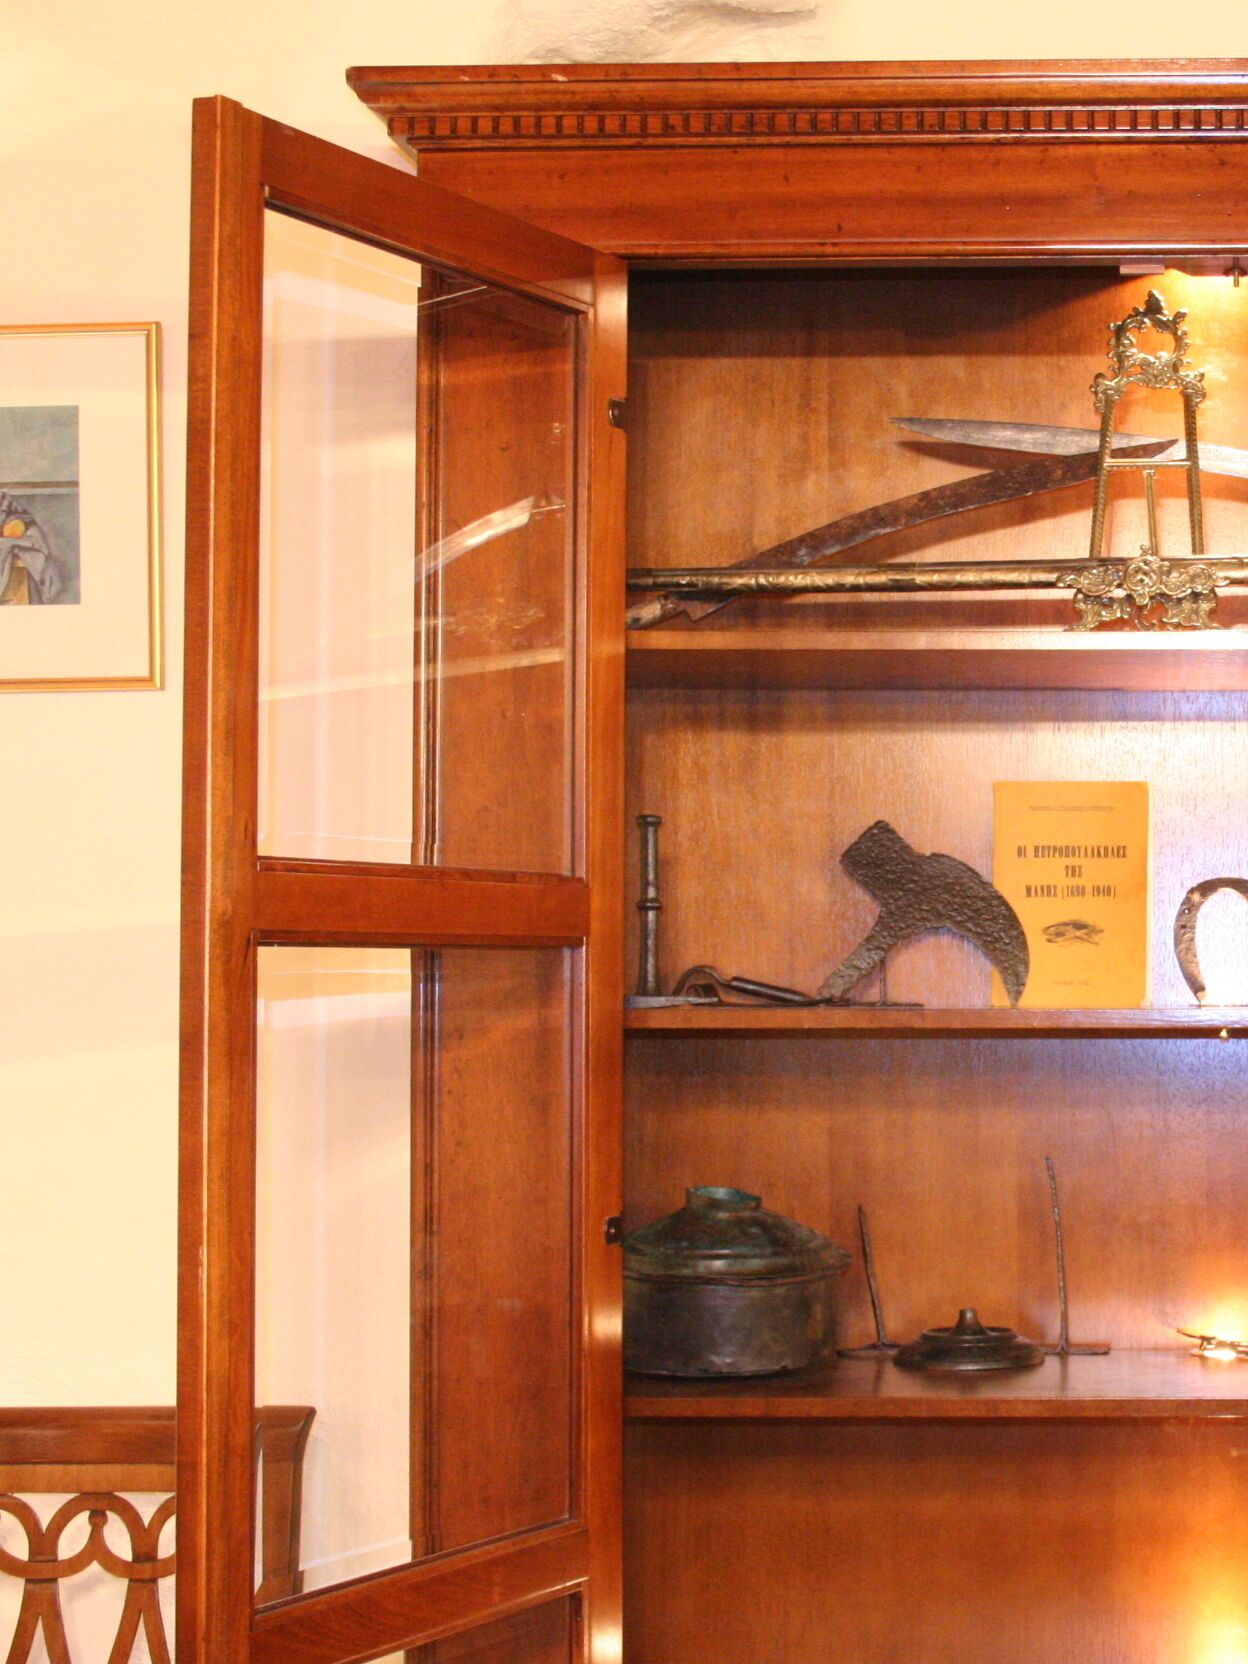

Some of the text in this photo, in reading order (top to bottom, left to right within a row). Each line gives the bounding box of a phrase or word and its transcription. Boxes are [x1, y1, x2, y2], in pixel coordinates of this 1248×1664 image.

[1017, 845, 1027, 858] ΟΙ
[1064, 865, 1083, 878] ΤΗΣ
[1025, 884, 1058, 898] ΜΑΝΗΣ
